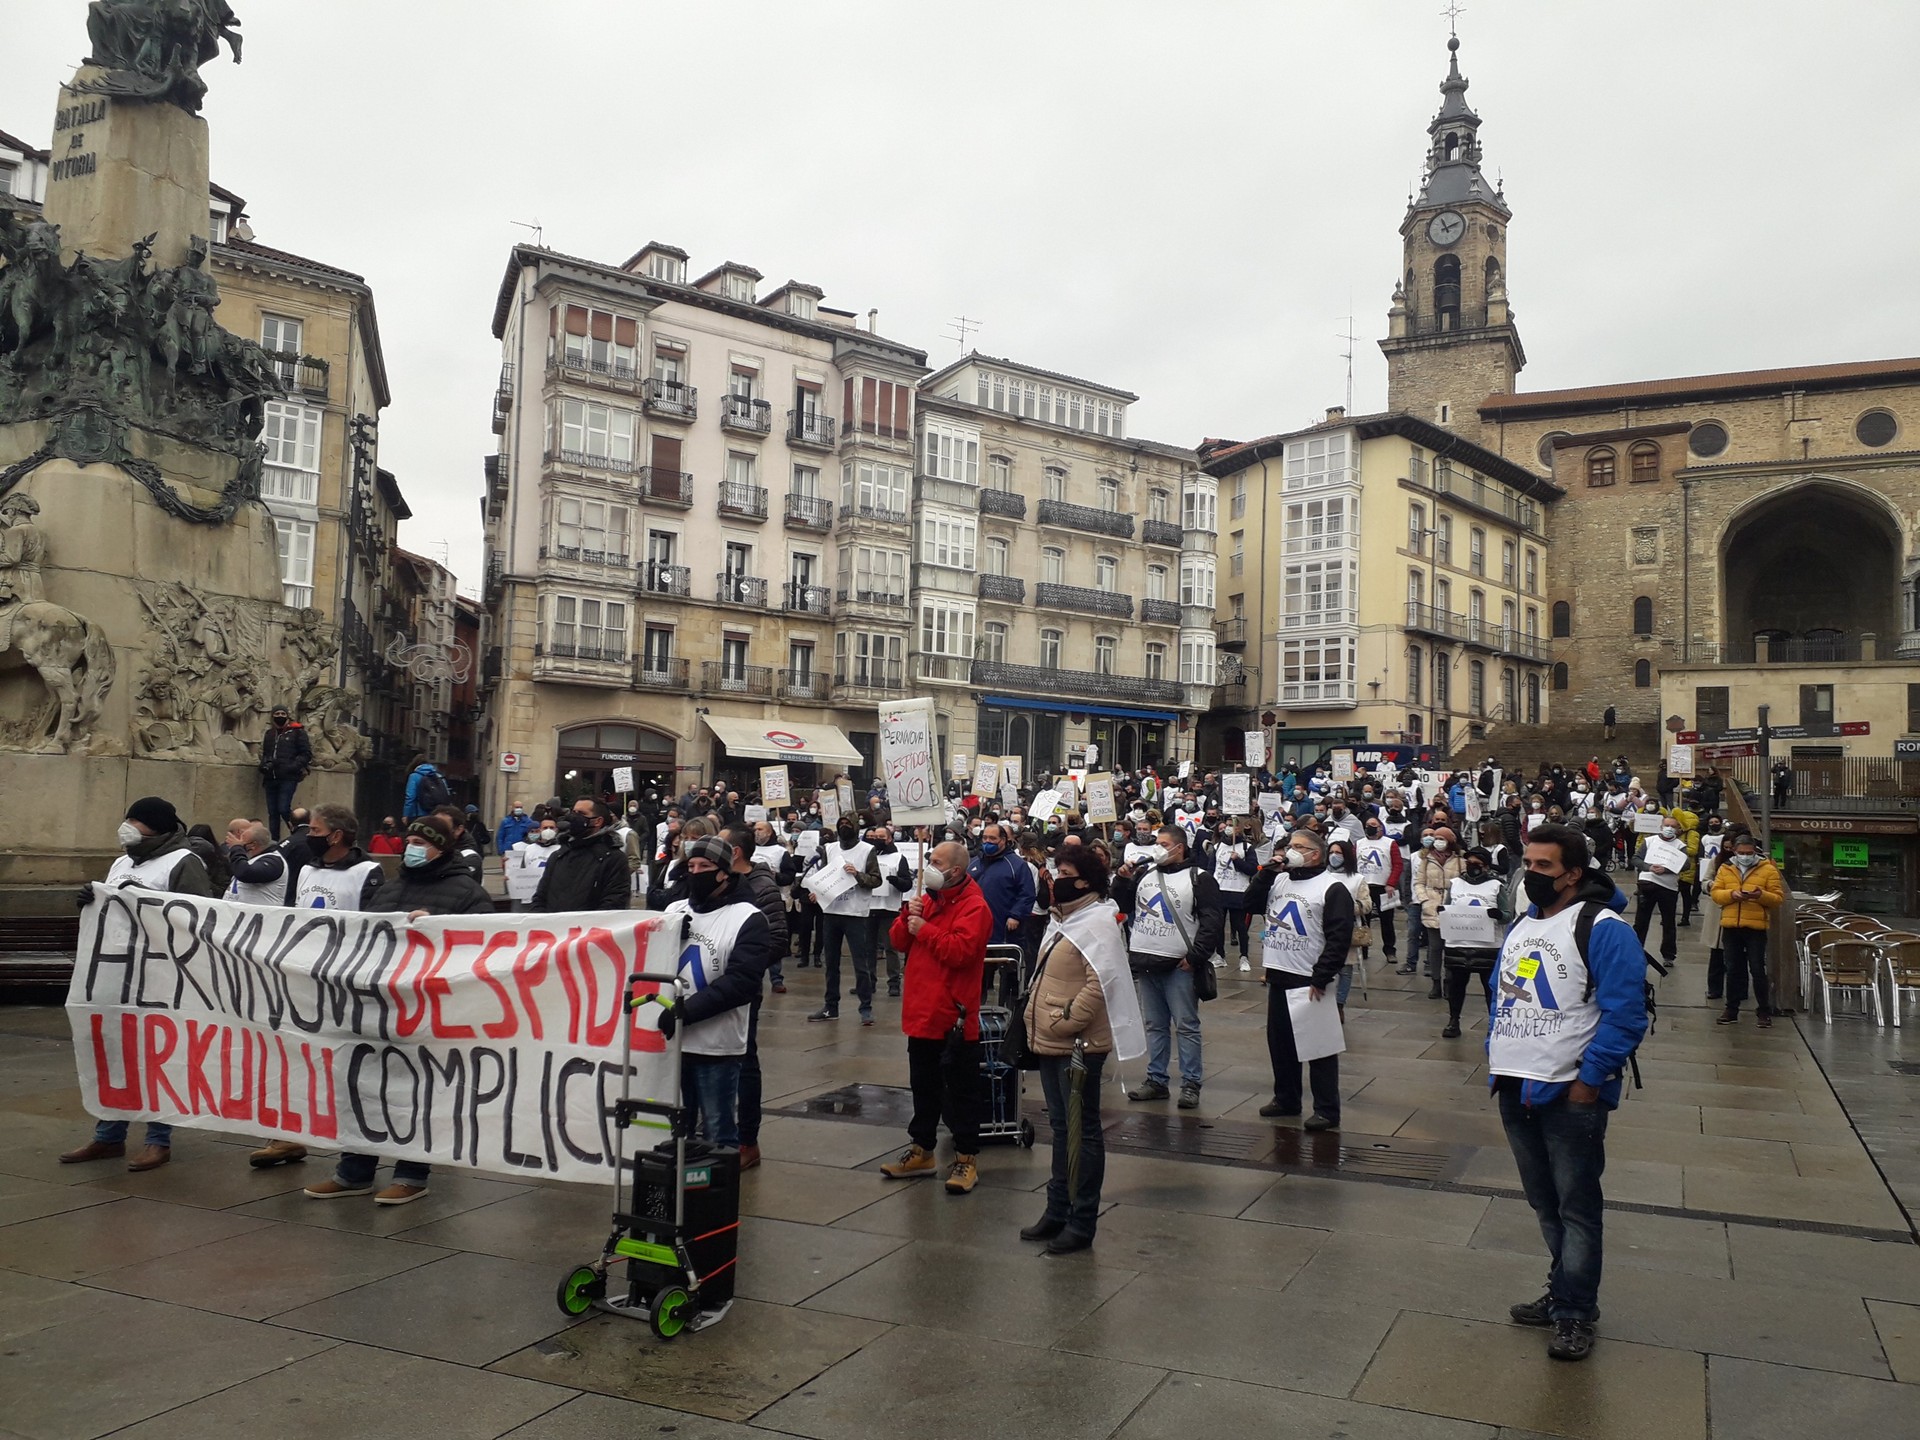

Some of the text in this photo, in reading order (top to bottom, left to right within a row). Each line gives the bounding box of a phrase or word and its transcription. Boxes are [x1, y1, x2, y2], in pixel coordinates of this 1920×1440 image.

[55, 99, 106, 131] BATALLA
[71, 133, 84, 149] DE
[53, 151, 97, 182] VITORIA
[898, 777, 925, 804] NO
[1801, 820, 1853, 830] COELLO
[86, 896, 397, 1039] AERNNOVA
[688, 931, 720, 972] espidos en
[1507, 943, 1521, 955] los
[1522, 937, 1562, 962] despidos
[1556, 963, 1568, 980] en
[387, 917, 667, 1053] DESPIDE
[90, 1013, 338, 1140] URKULLU
[348, 1043, 637, 1173] COMPLICE
[686, 1170, 708, 1184] ELA
